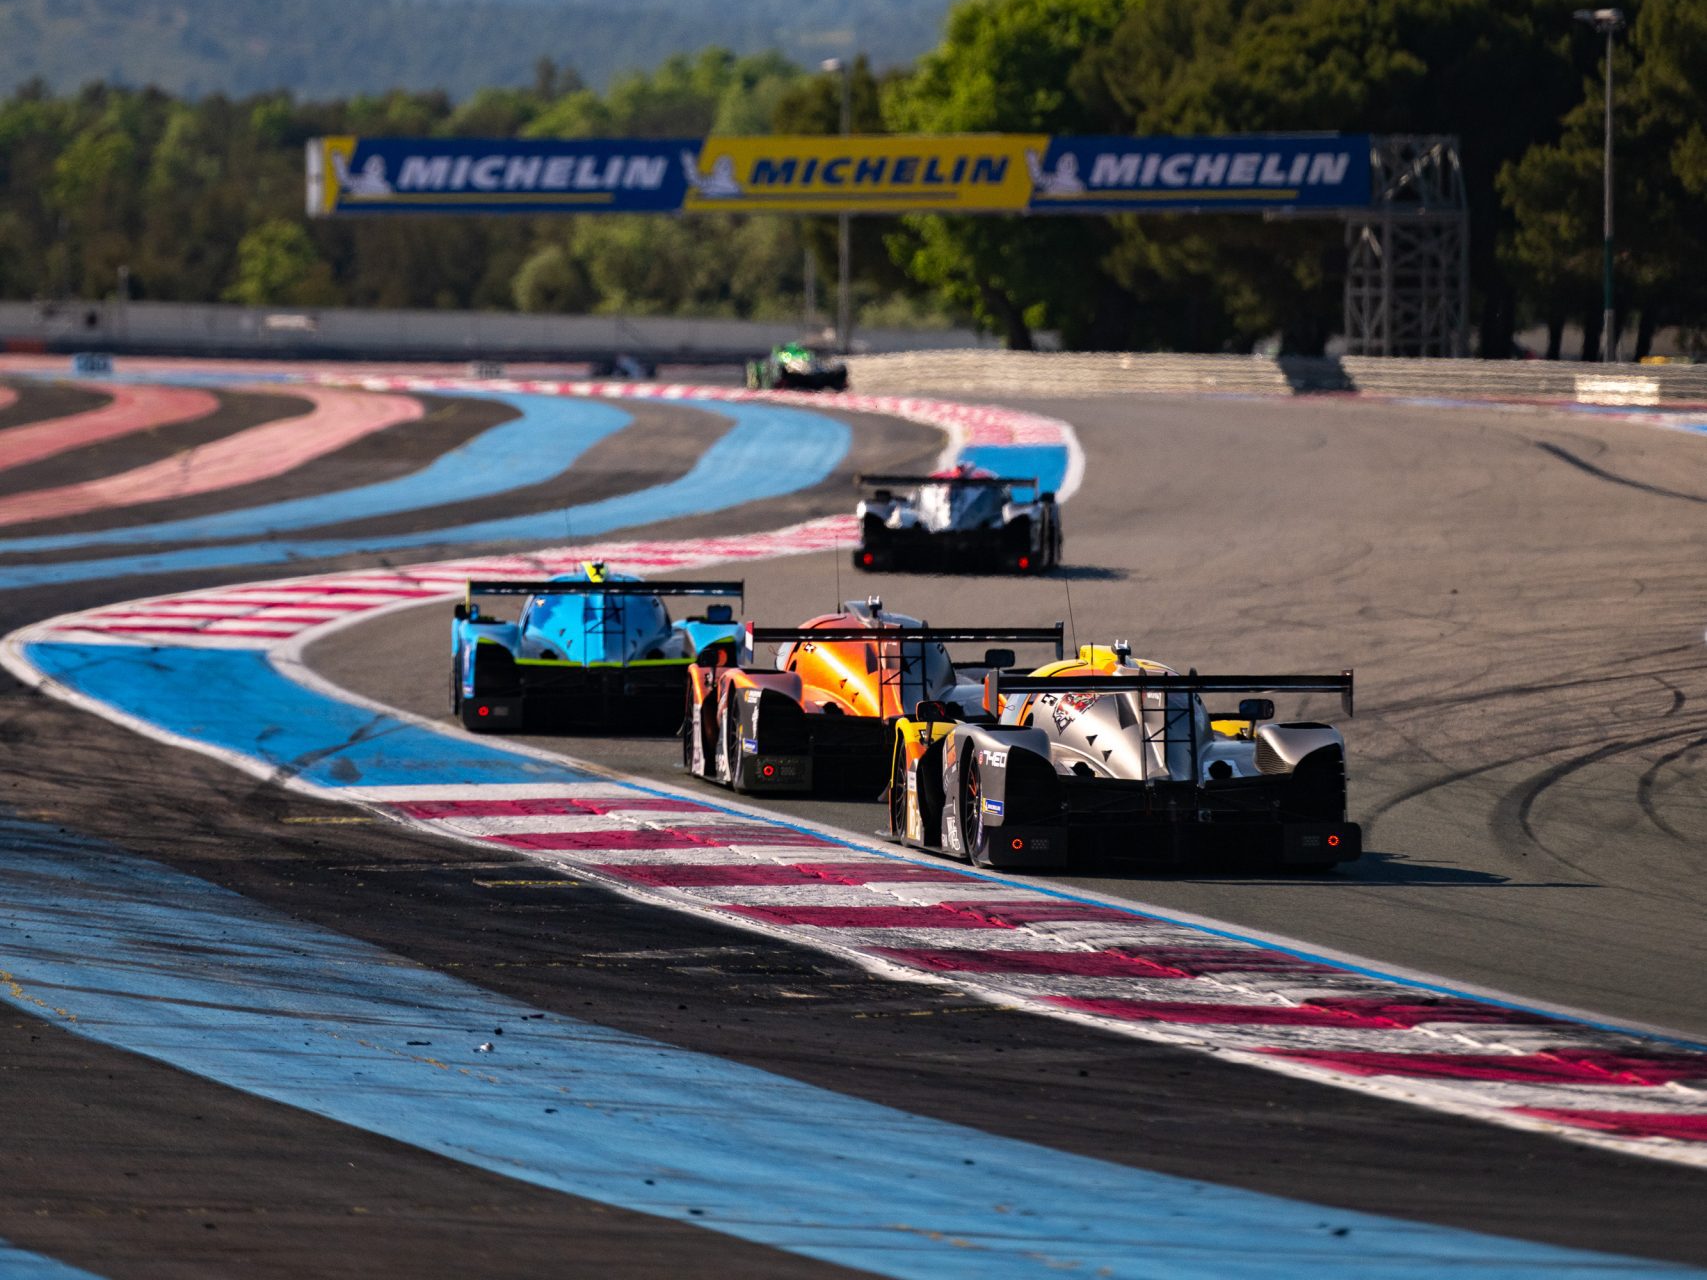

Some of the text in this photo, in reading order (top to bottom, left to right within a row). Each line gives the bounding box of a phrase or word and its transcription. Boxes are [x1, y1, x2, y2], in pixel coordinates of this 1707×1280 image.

[397, 154, 670, 190] MICHELIN
[750, 155, 1010, 186] MICHELIN
[1088, 151, 1350, 186] MICHELIN
